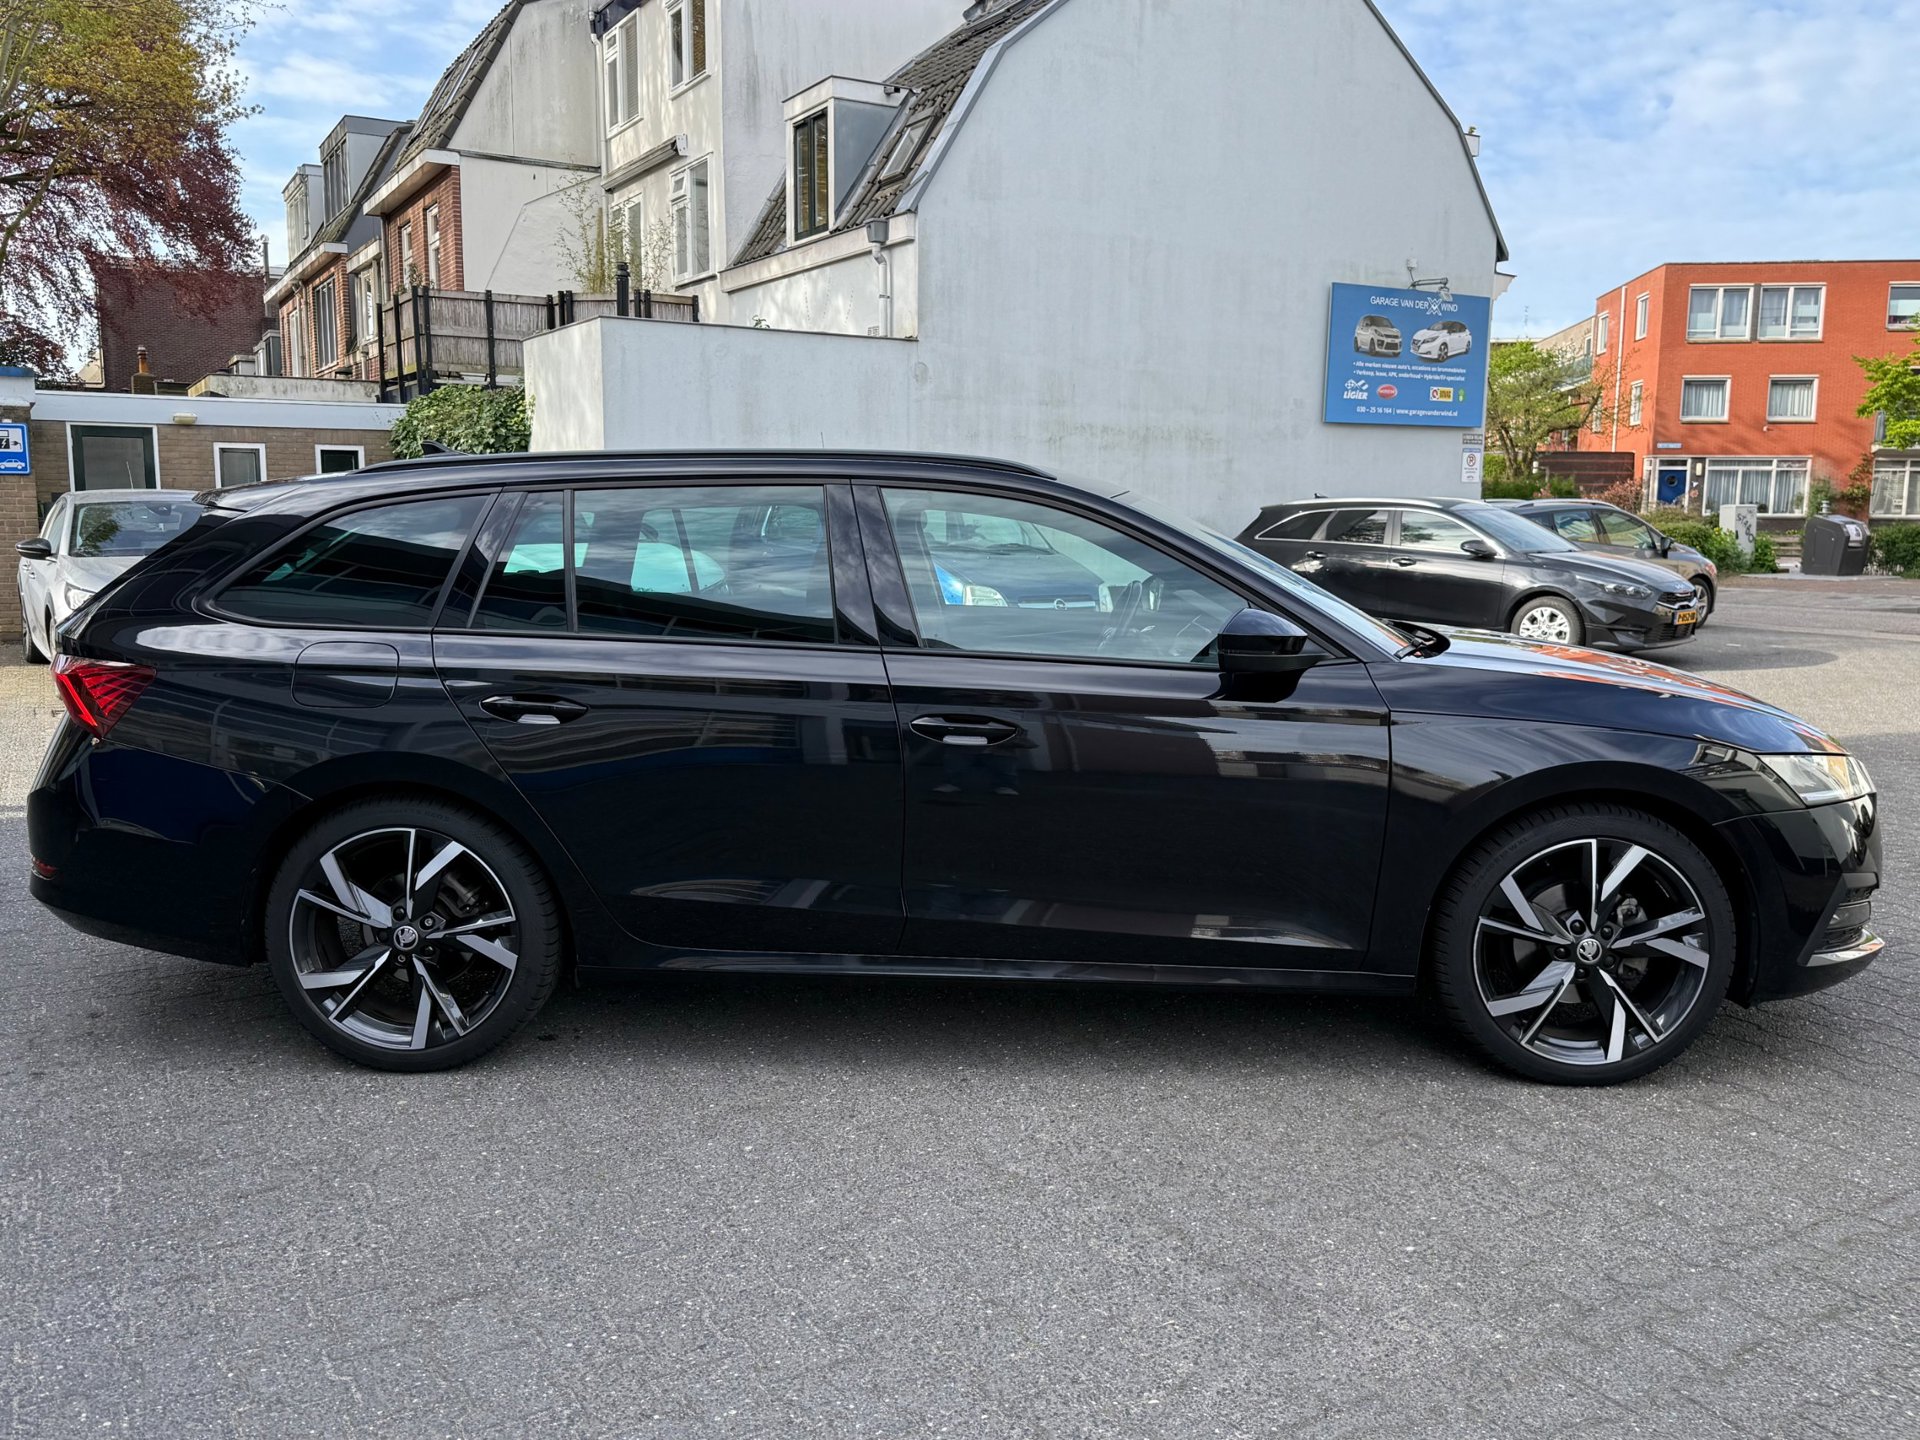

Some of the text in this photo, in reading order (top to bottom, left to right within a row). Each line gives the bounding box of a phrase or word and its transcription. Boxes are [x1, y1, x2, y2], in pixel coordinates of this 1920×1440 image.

[1370, 295, 1458, 312] GARAGE VAN DER WIND
[1343, 389, 1368, 400] LIGIER
[1396, 409, 1458, 417] www.garagevanderwind.nl
